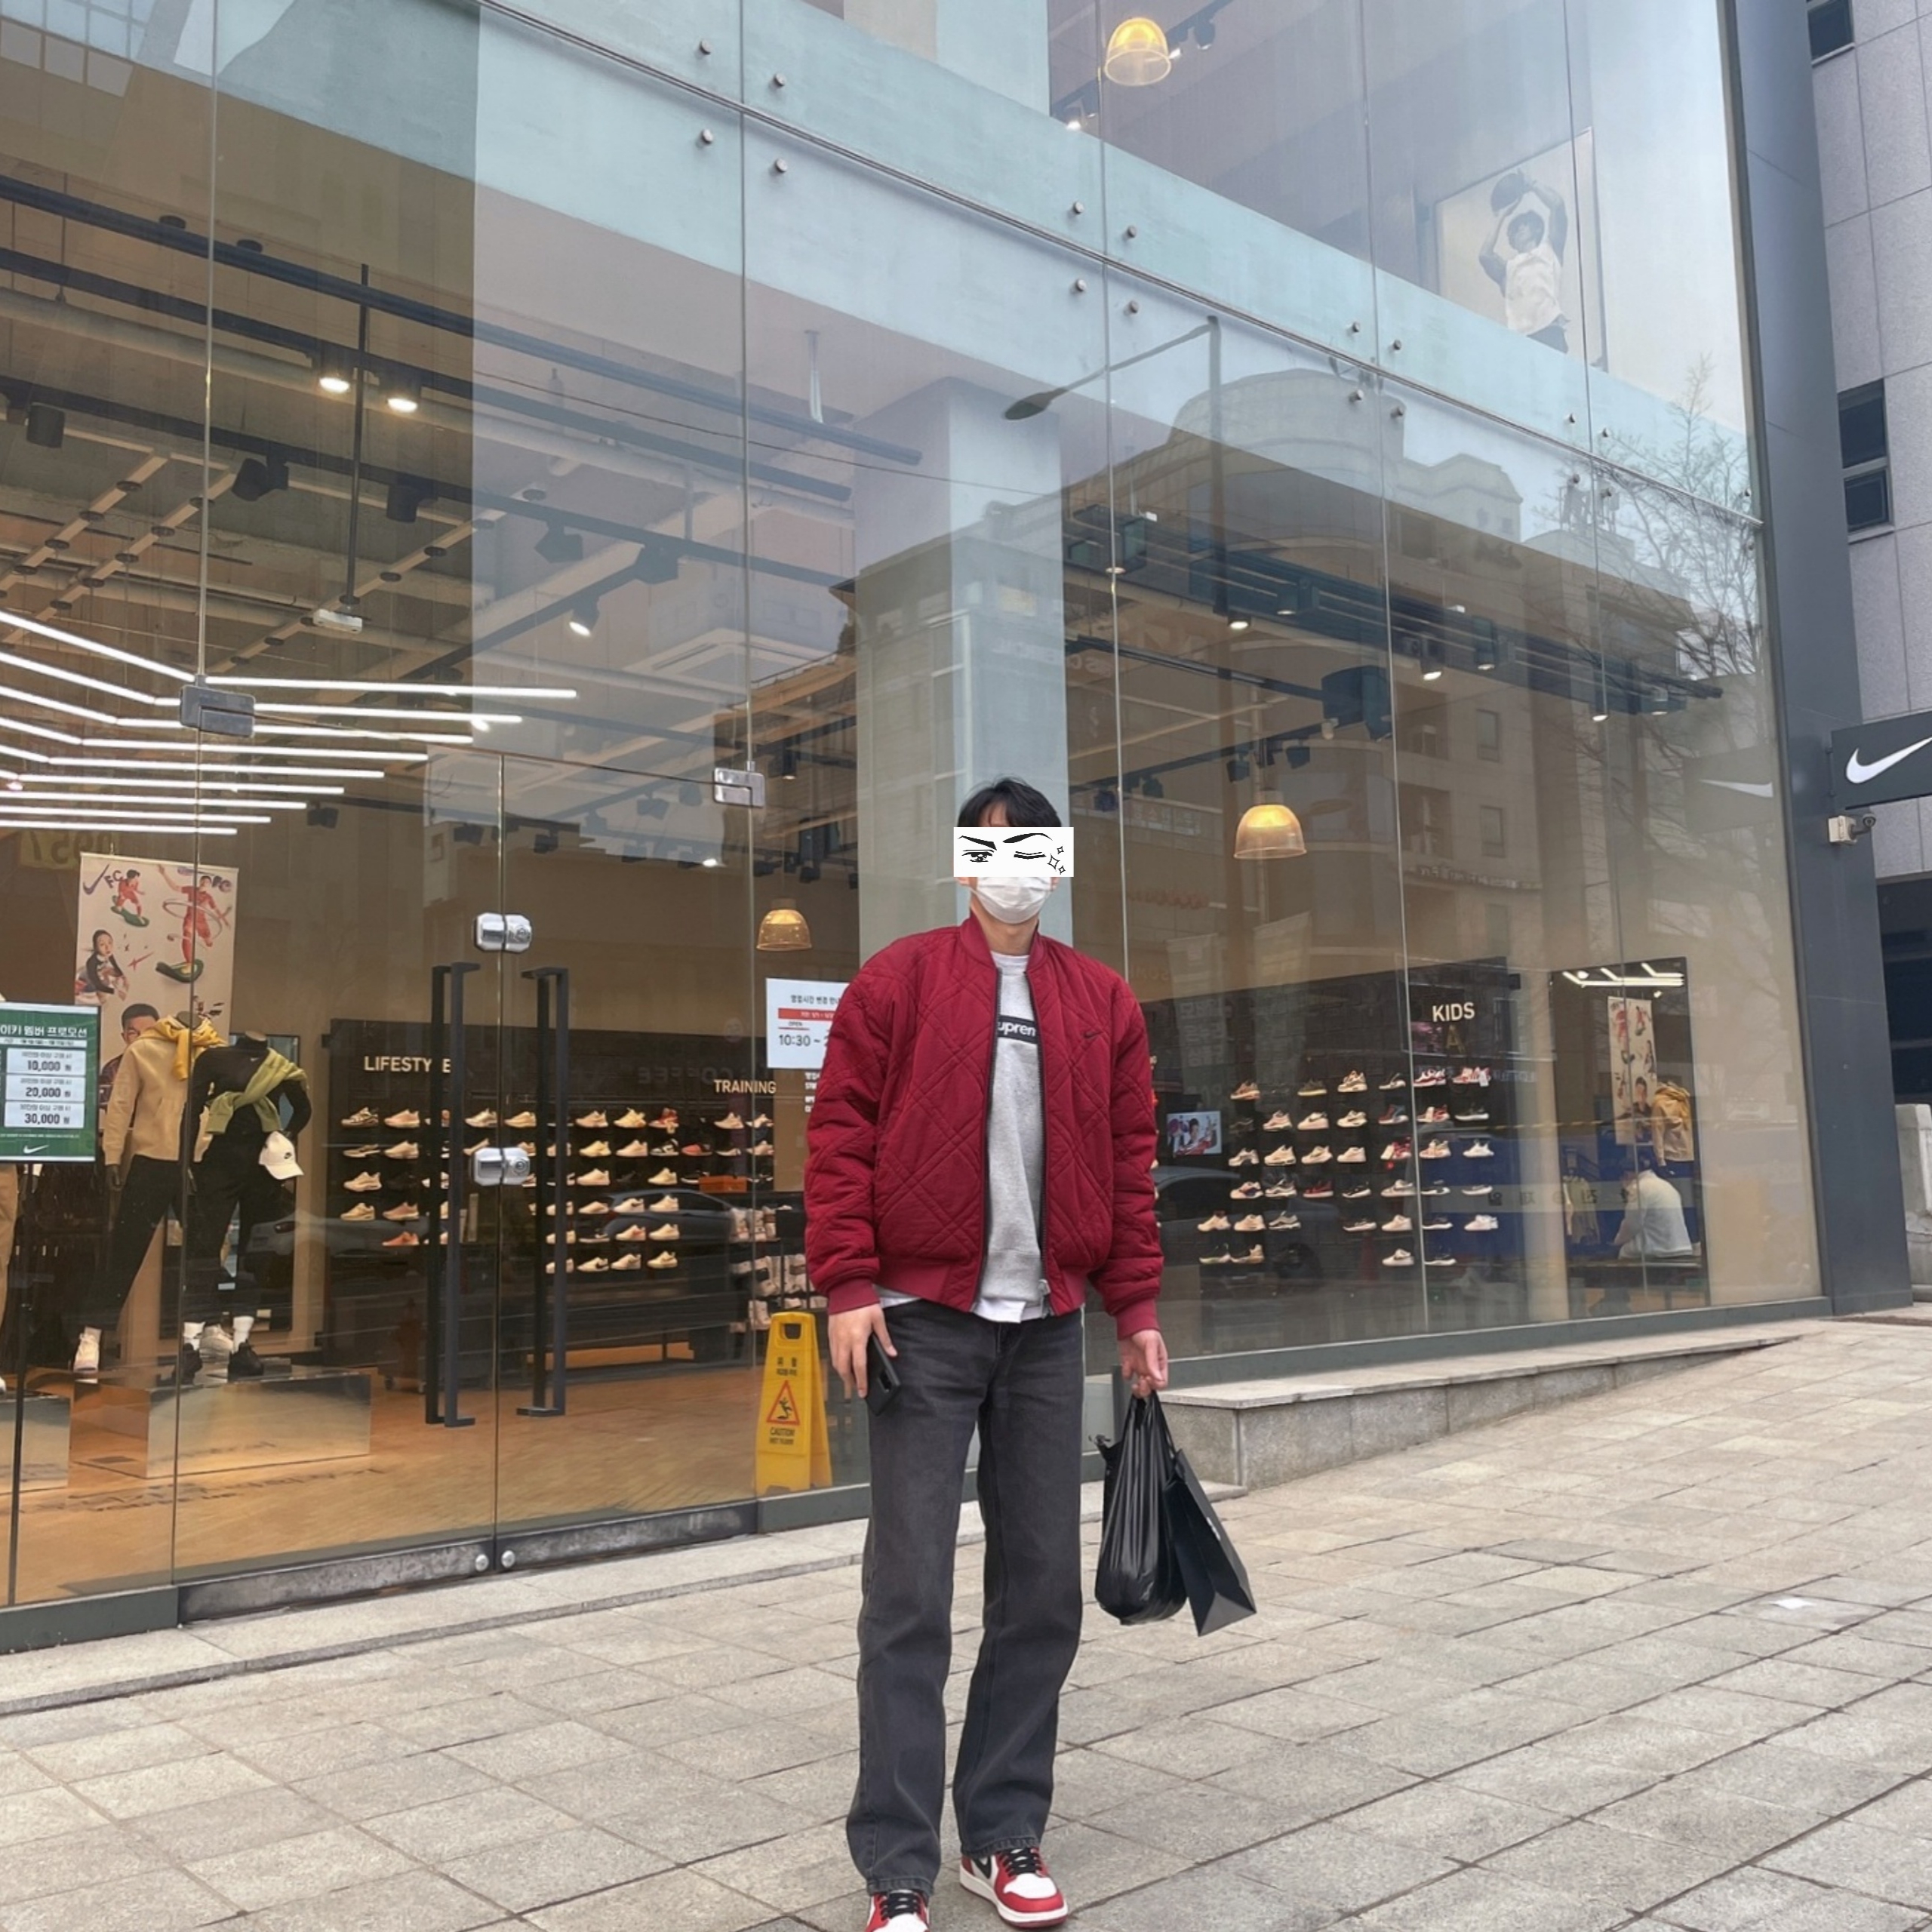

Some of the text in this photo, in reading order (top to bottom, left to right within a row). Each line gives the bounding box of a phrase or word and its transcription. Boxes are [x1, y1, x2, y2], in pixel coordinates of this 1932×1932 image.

[1432, 1001, 1475, 1023] KIDS
[24, 1026, 45, 1036] 멤버
[47, 1026, 88, 1038] 프로모션
[779, 1034, 811, 1047] 10:30
[27, 1060, 60, 1072] 10,000
[364, 1056, 451, 1073] LIFESTYE
[25, 1087, 61, 1098] 20,000
[713, 1079, 777, 1094] TRAINING
[24, 1113, 60, 1125] 30,000
